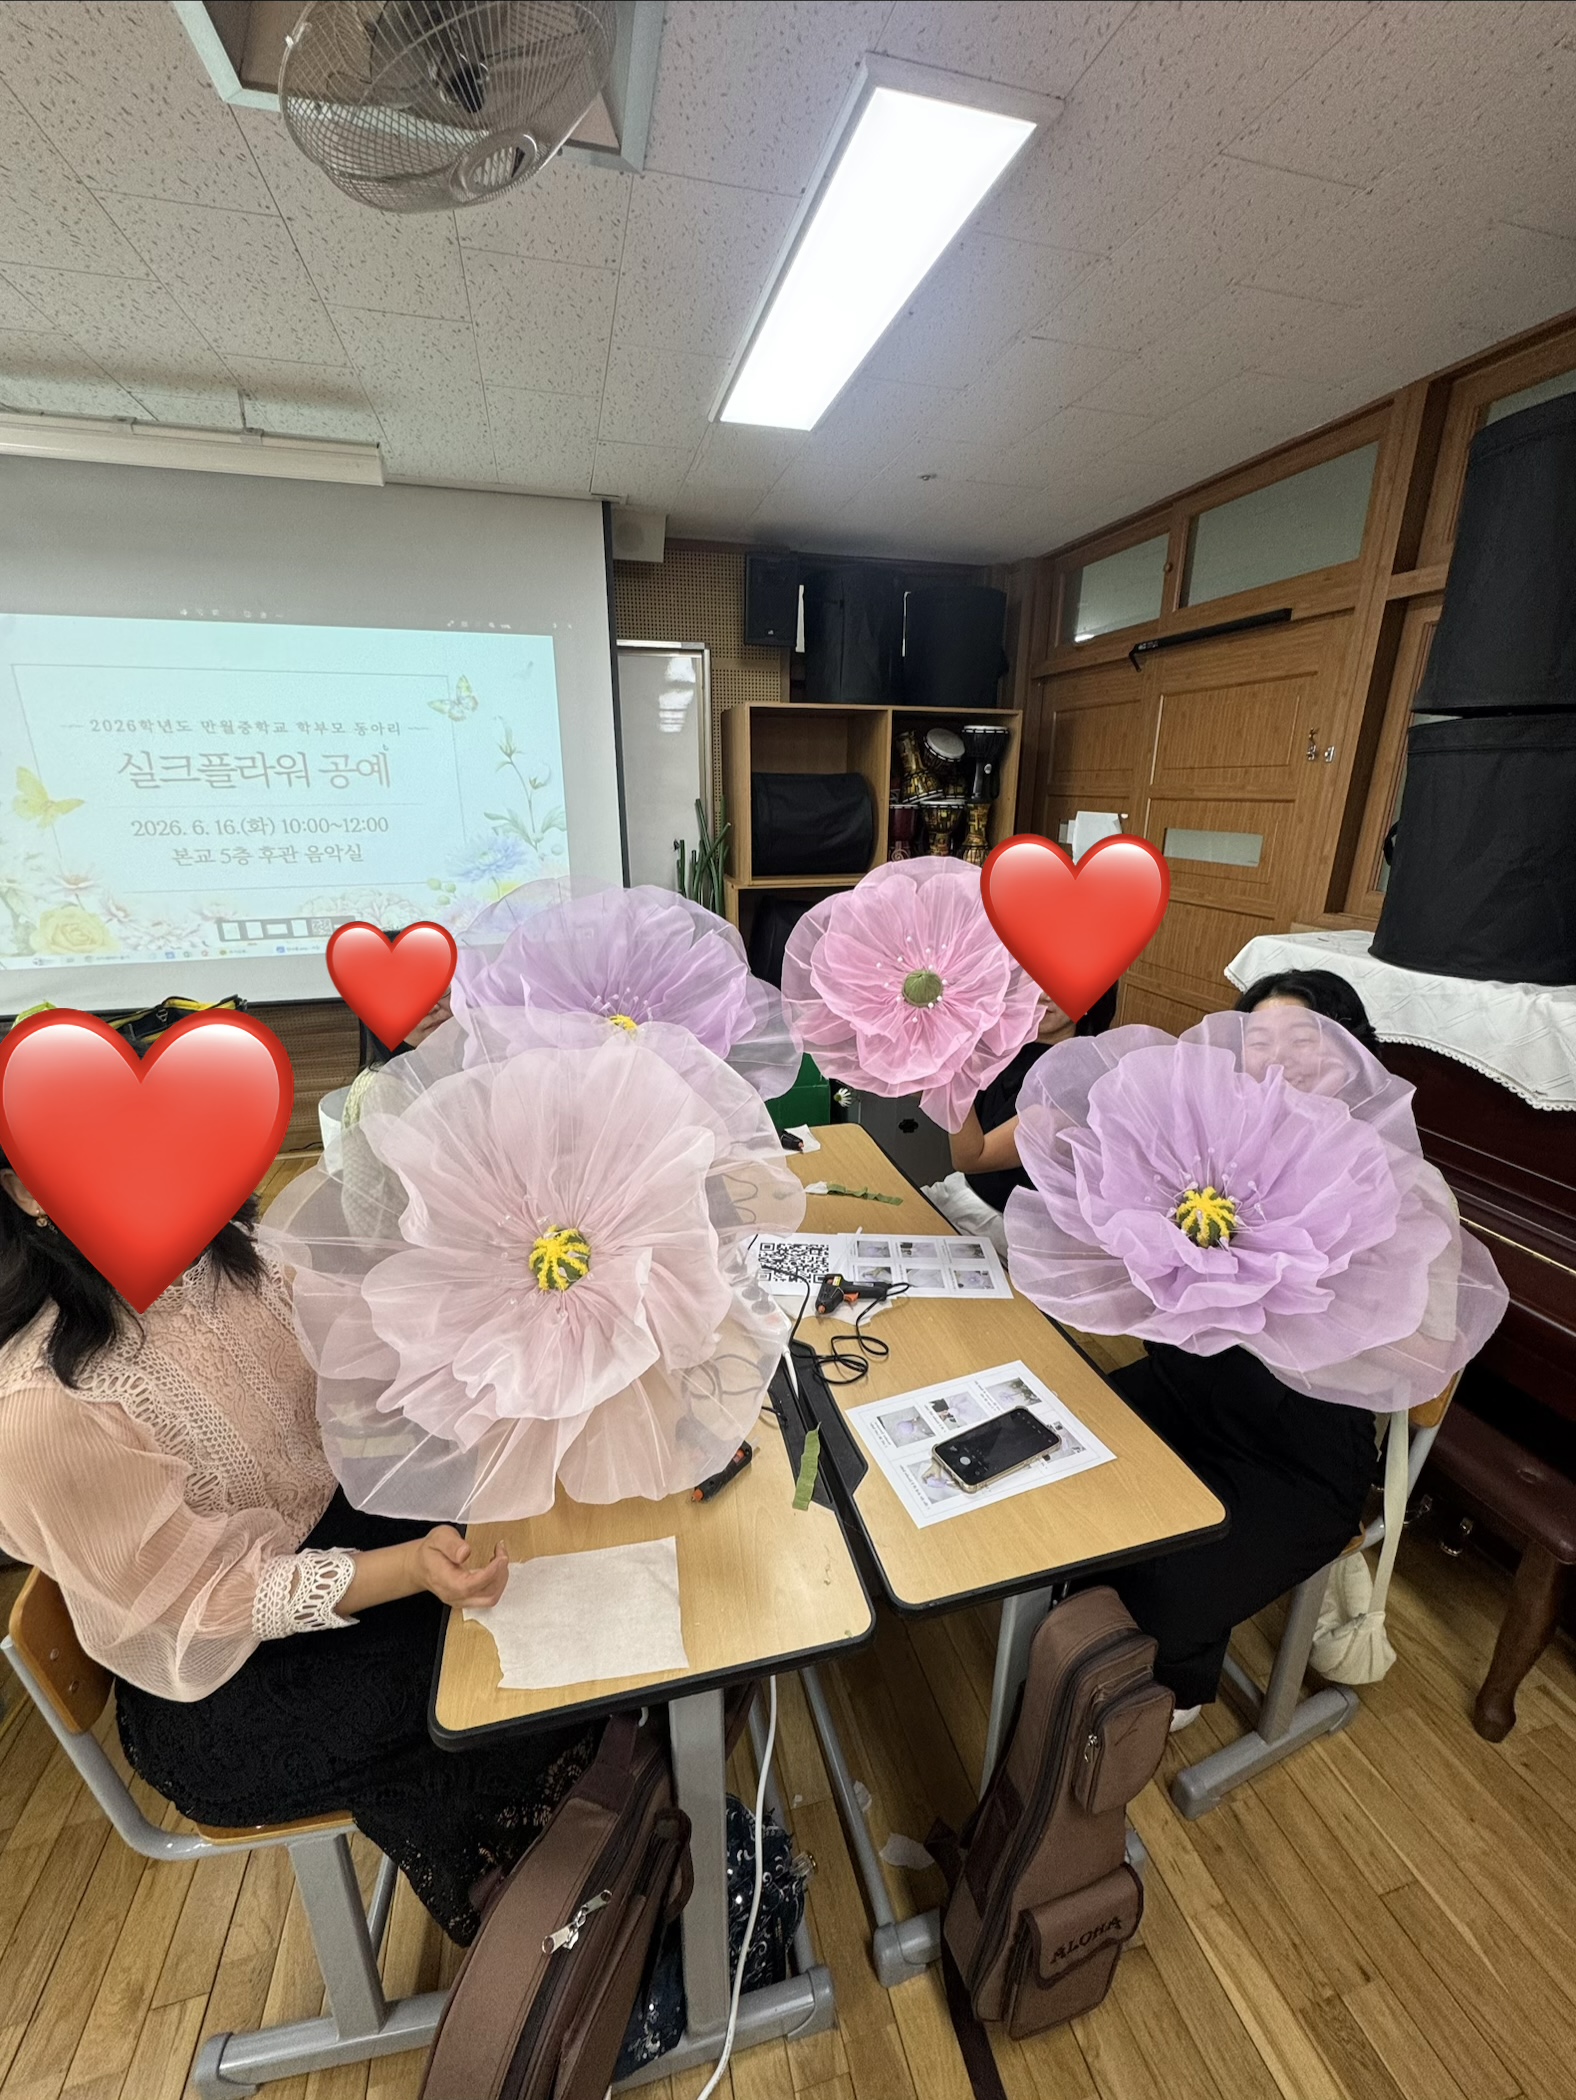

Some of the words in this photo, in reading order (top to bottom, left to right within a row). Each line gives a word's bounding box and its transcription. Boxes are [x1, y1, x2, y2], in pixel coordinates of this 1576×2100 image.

[89, 719, 193, 734] 2026학년도
[201, 719, 288, 736] 만월중학교
[296, 721, 346, 736] 학부모
[354, 721, 401, 736] 동아리
[118, 750, 310, 789] 실크플라워
[318, 751, 390, 789] 공예
[131, 819, 187, 836] 2026.
[282, 817, 389, 834] 10:00~12:00
[172, 847, 216, 866] 본교
[220, 846, 254, 866] 5층
[258, 845, 299, 864] 후관
[304, 843, 364, 864] 음악실
[1050, 1916, 1122, 1964] ALOHA
